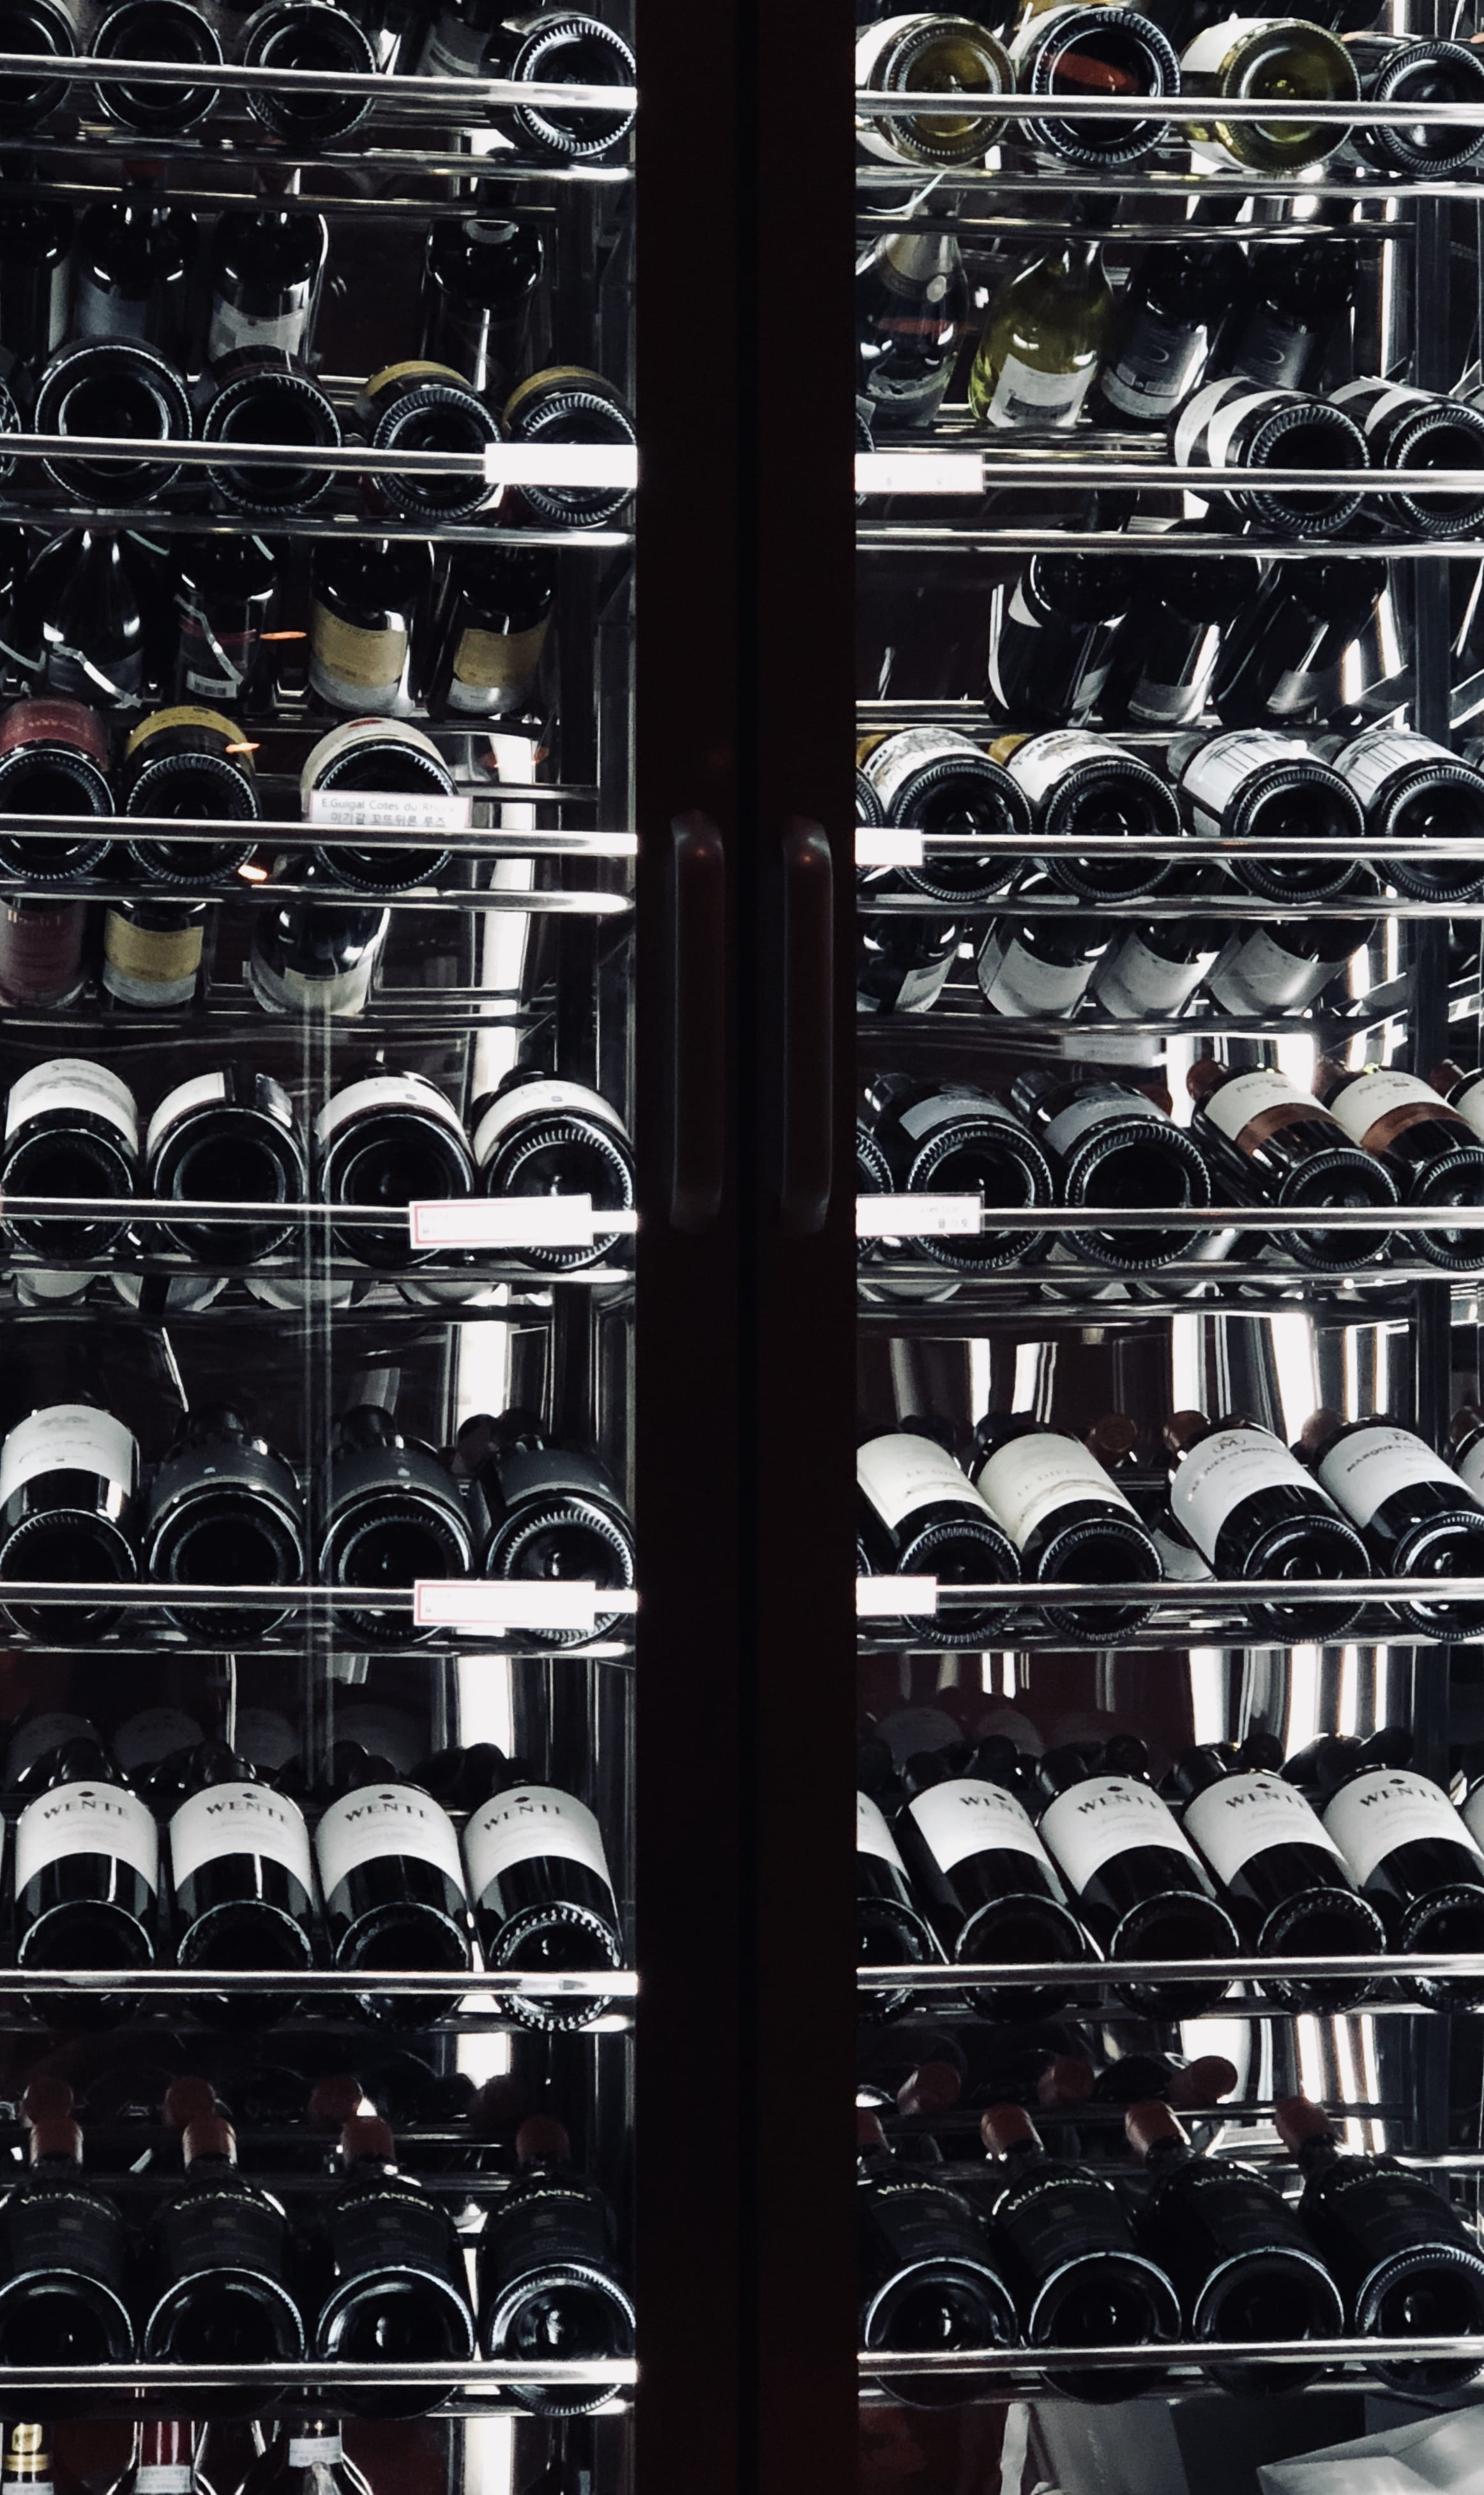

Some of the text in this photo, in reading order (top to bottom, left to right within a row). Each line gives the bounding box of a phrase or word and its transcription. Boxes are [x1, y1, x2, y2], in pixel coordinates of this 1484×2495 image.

[321, 797, 365, 811] E.Guigal
[369, 800, 399, 810] Cotes
[404, 801, 418, 811] du
